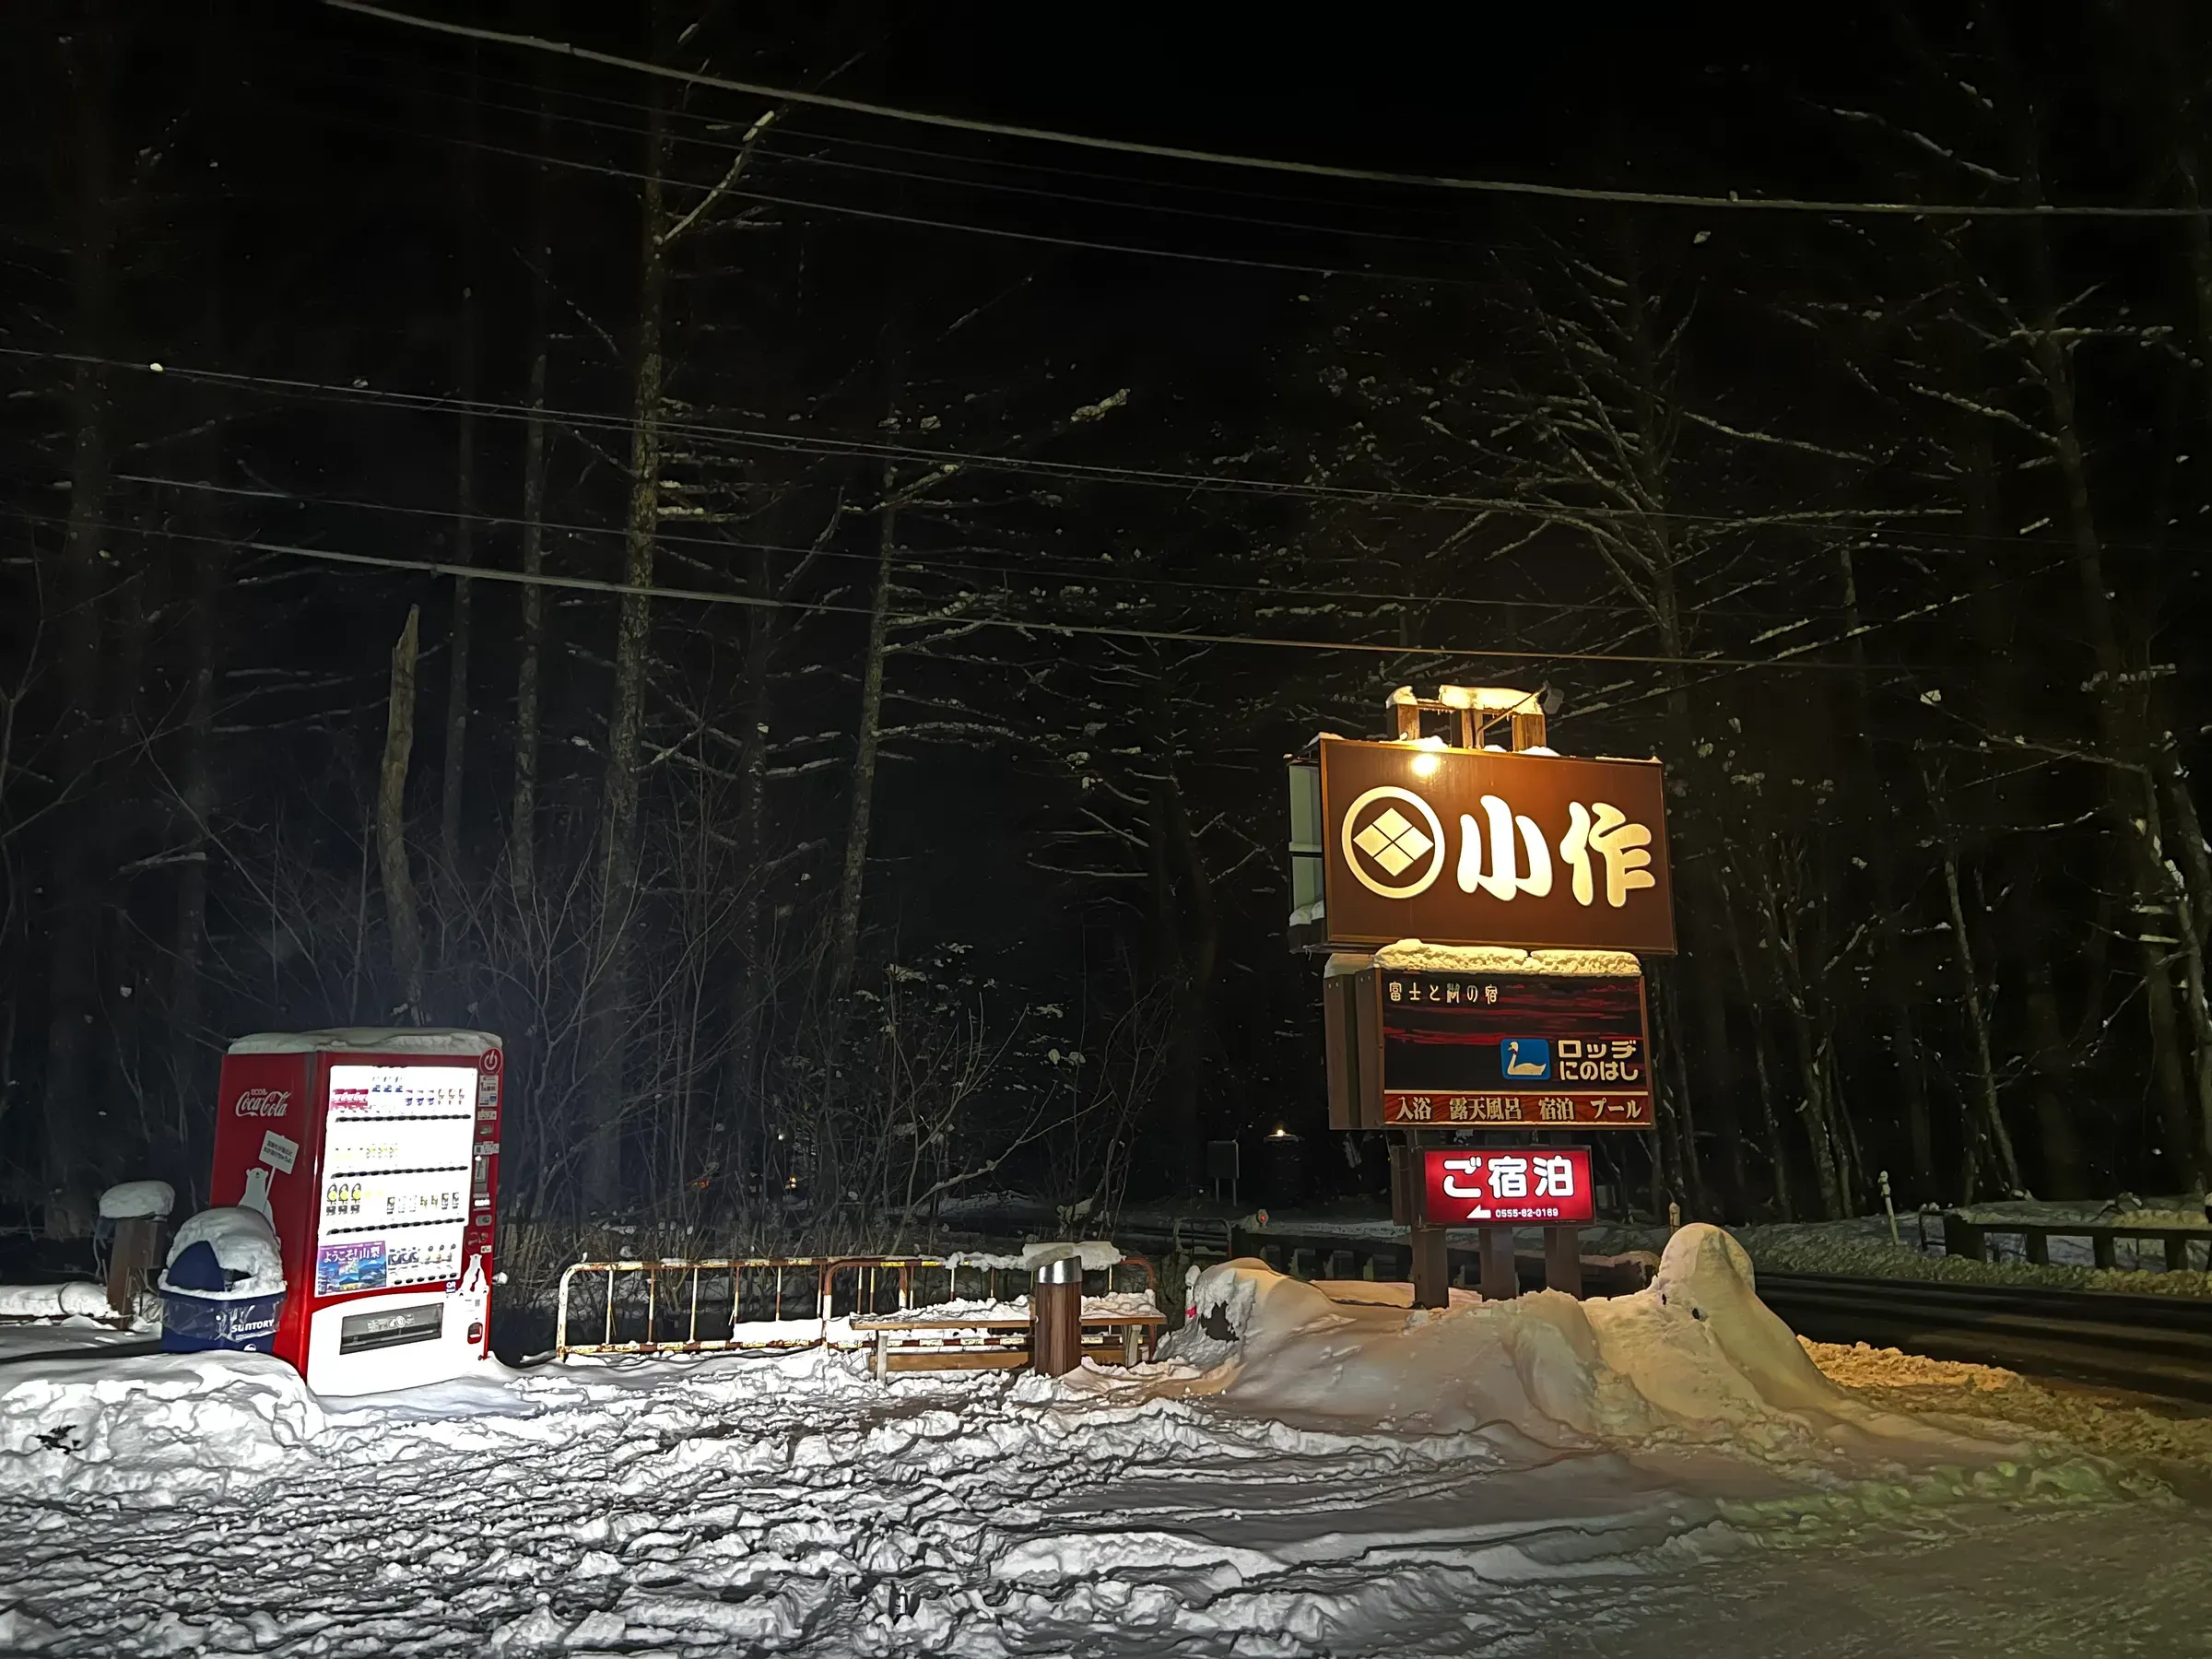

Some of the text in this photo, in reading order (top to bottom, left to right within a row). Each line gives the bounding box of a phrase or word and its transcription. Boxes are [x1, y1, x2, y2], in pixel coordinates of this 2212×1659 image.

[1456, 794, 1655, 908] 小作
[1559, 1061, 1639, 1081] にのはし
[235, 1091, 292, 1117] Coca-Cola
[1395, 1096, 1642, 1121] 入浴 露天風呂 宿泊 プール
[1443, 1155, 1574, 1199] ご宿泊
